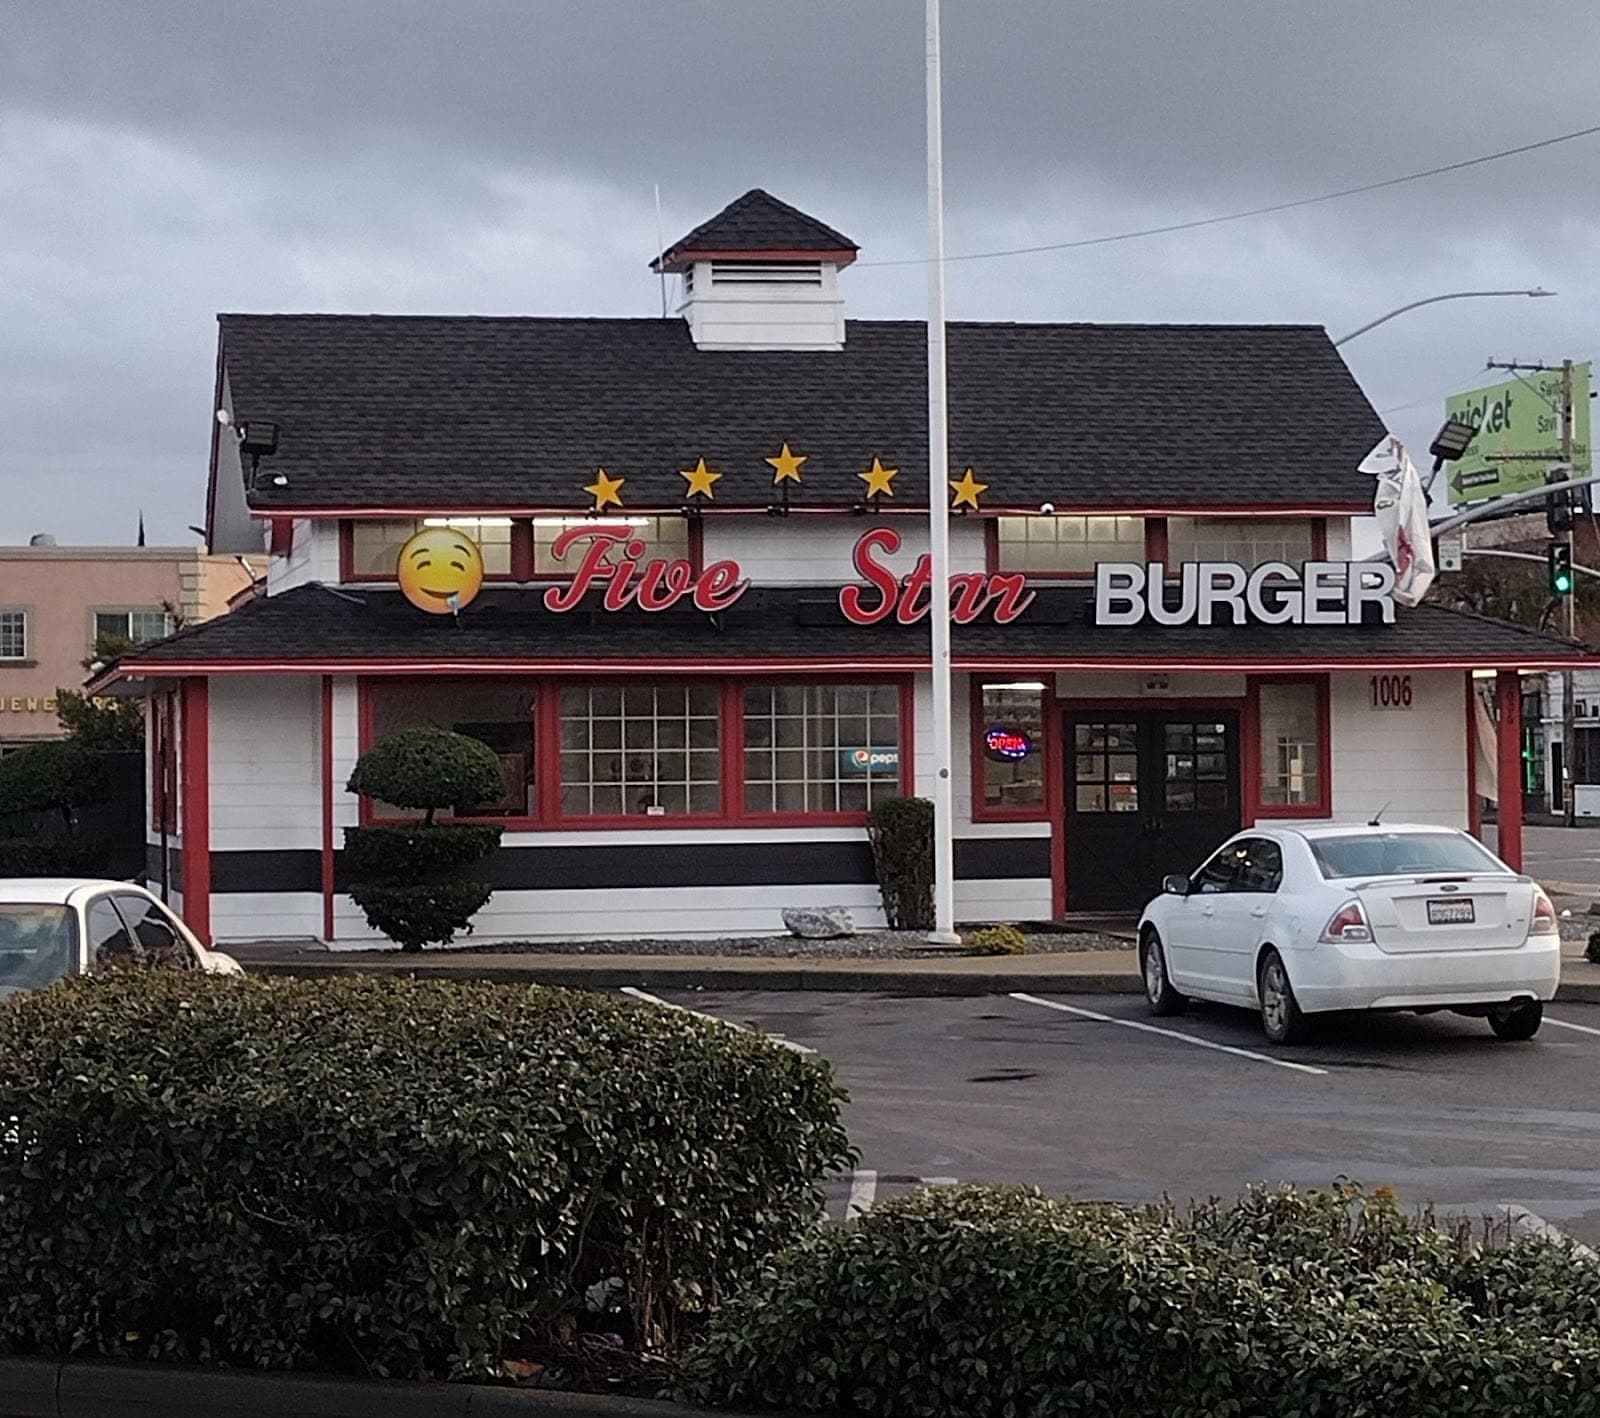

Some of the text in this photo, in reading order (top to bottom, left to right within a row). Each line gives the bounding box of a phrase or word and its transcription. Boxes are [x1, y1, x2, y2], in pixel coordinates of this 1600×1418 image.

[544, 525, 1396, 627] Five Star BURGER
[1370, 675, 1412, 706] 1006
[870, 753, 898, 765] peps
